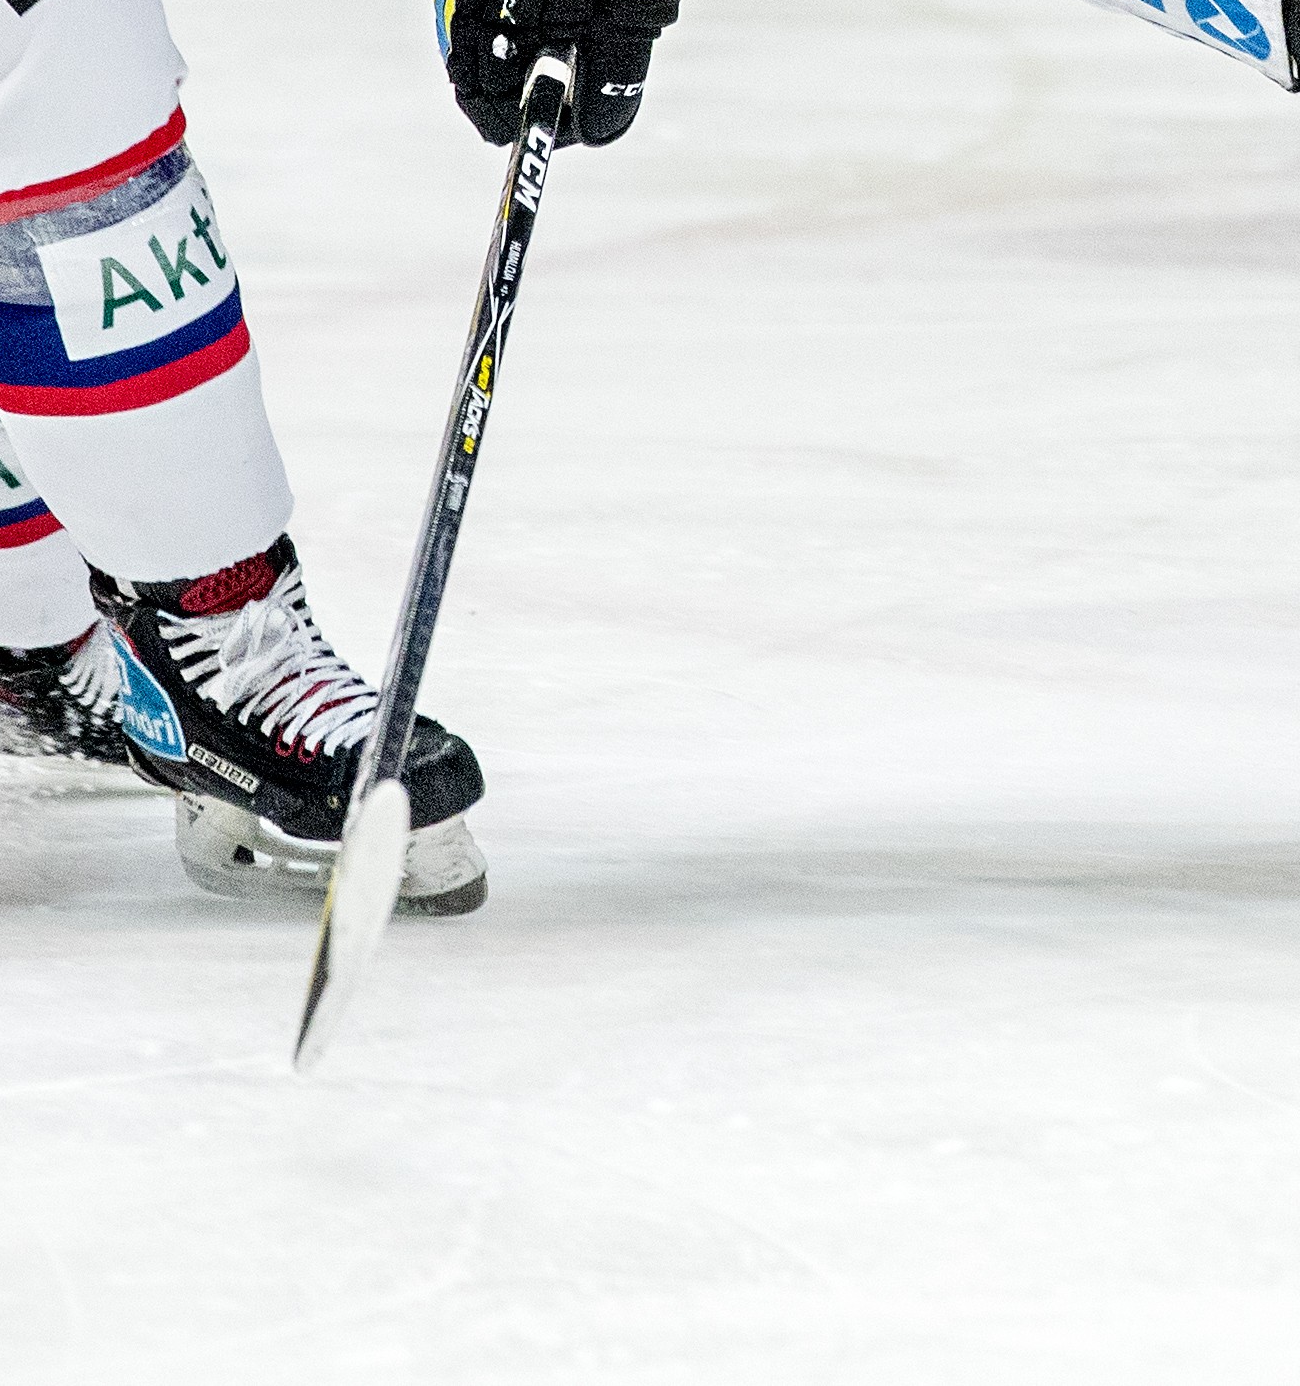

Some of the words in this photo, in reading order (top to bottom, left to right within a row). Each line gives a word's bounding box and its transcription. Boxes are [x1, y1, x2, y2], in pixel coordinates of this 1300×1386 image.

[514, 125, 554, 214] CCM
[99, 190, 228, 331] Akt
[190, 745, 254, 790] BAUER
